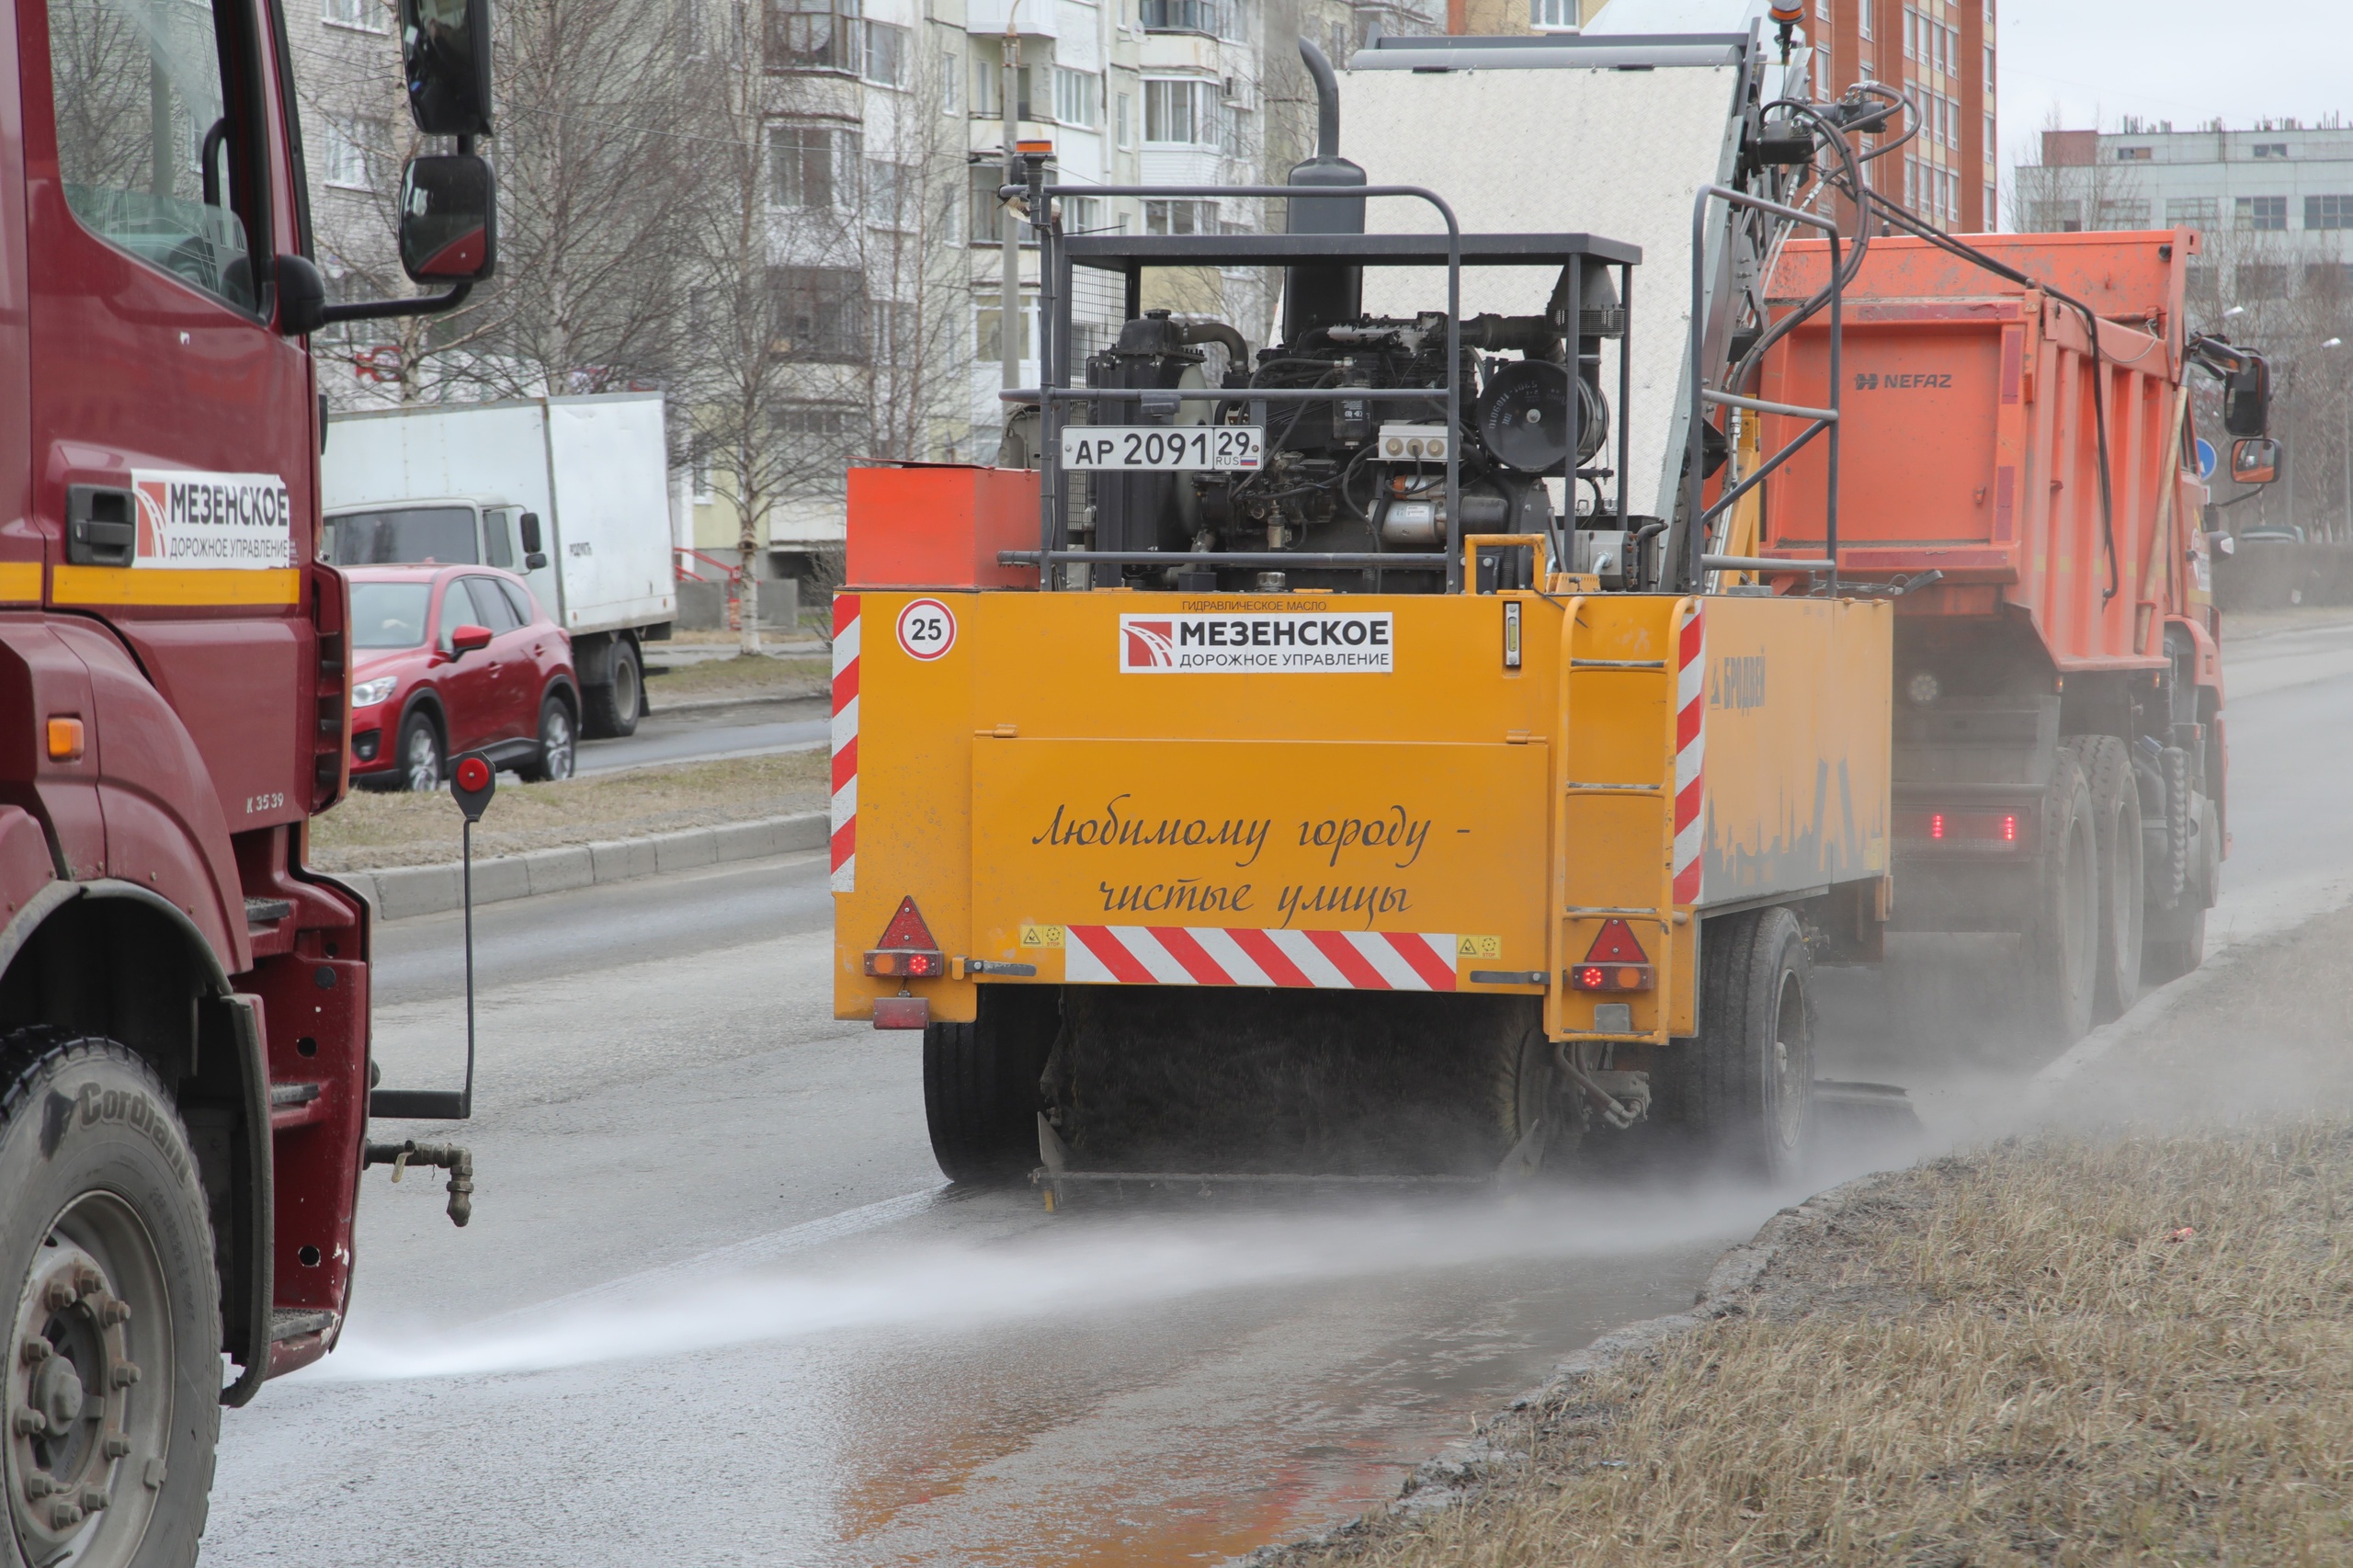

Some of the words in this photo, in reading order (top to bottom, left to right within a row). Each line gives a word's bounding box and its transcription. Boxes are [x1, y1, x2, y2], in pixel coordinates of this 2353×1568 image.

[1884, 374, 1952, 389] NEFAZ
[1074, 440, 1114, 465] АР
[1123, 433, 1206, 465] 2091
[1218, 431, 1250, 456] 29
[1216, 456, 1240, 466] RUS
[170, 483, 289, 528] МЕЗЕНСКОЕ
[169, 537, 228, 561] ДОРОЖНОЕ
[230, 539, 289, 559] УПРАВЛЕНИЕ
[1182, 600, 1283, 612] ГИДРАВЛИЧЕСКОЕ
[1287, 600, 1327, 611] МАСЛО
[911, 618, 942, 641] 25
[1179, 619, 1390, 646] МЕЗЕНСКОЕ
[1179, 653, 1279, 668] ДОРОЖНОЕ
[1283, 653, 1390, 667] УПРАВЛЕНИЕ
[1723, 645, 1766, 716] БРОДВЕЙ
[1031, 793, 1271, 868] Любимому
[1298, 805, 1432, 869] городу
[1098, 876, 1255, 913] чистые
[1278, 882, 1414, 931] улицы
[78, 1082, 193, 1185] Cordiant
